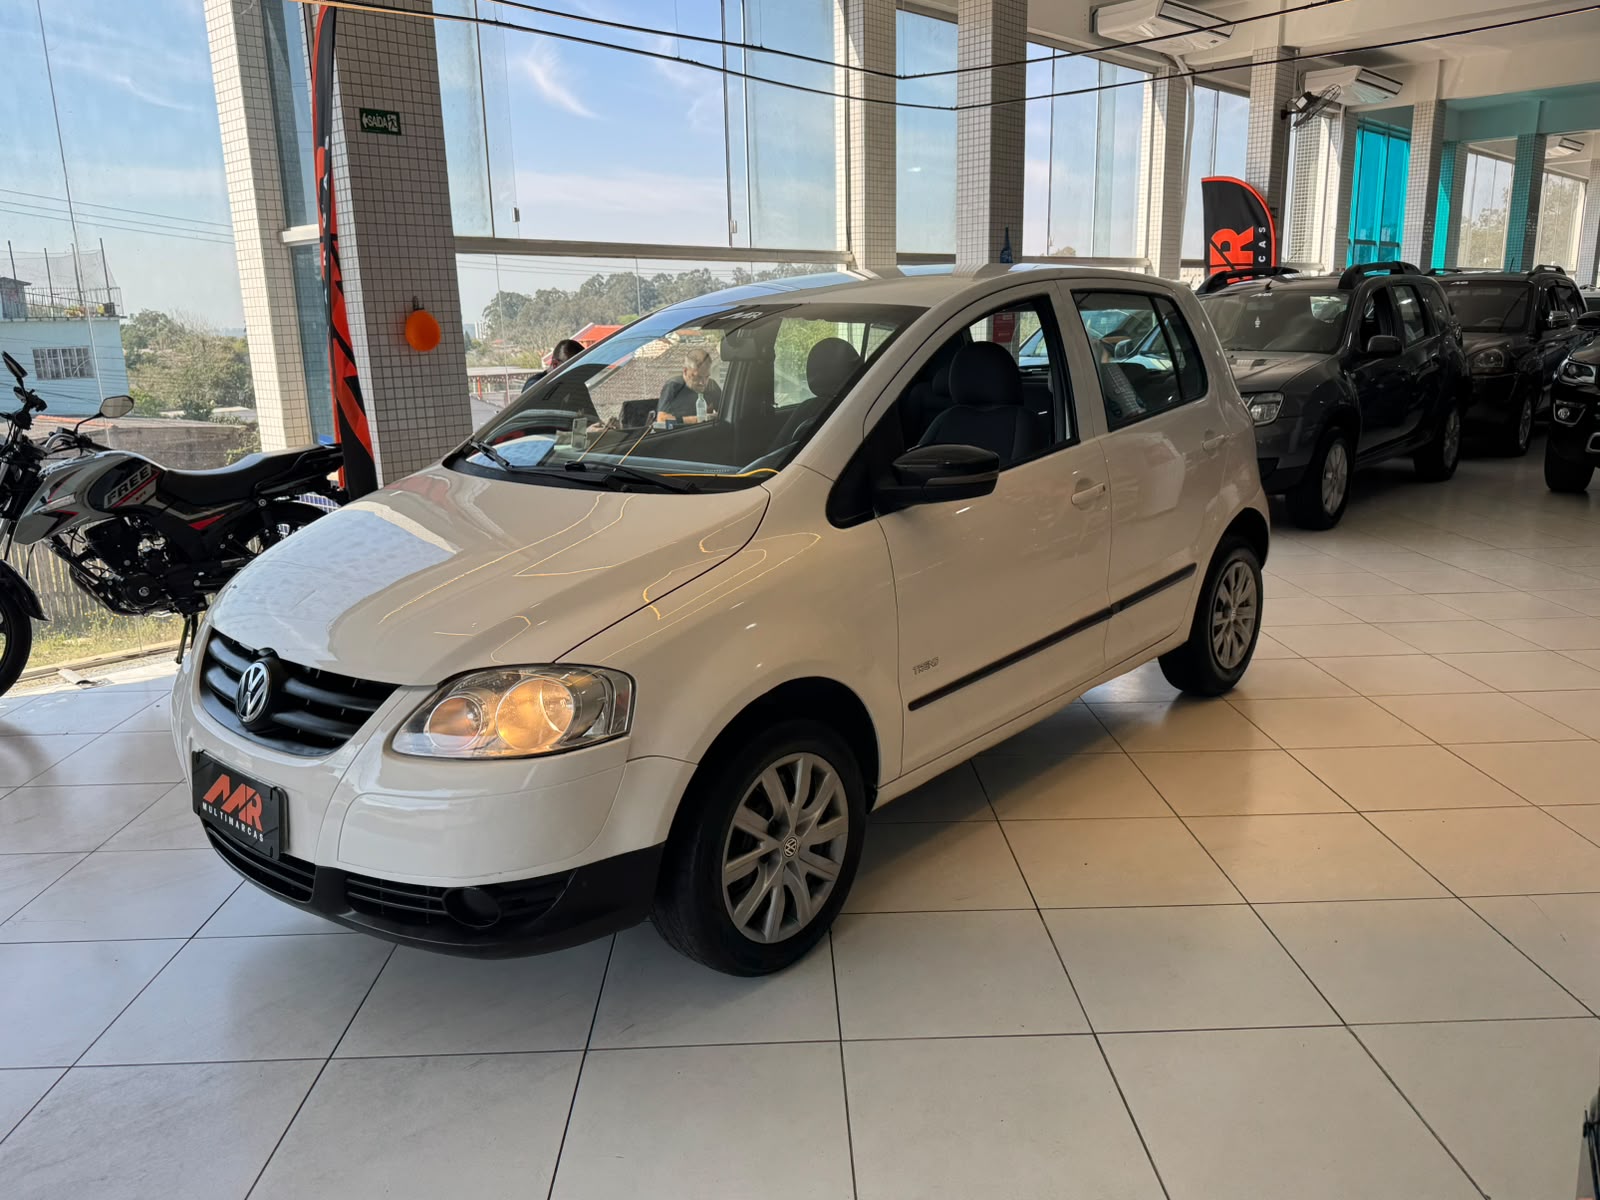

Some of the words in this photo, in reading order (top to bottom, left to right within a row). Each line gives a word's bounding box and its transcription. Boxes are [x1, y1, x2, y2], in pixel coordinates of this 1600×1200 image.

[1258, 226, 1267, 275] CAS
[107, 465, 150, 505] FREE
[202, 801, 264, 842] MULTIMARCAS
[203, 773, 264, 832] MR
